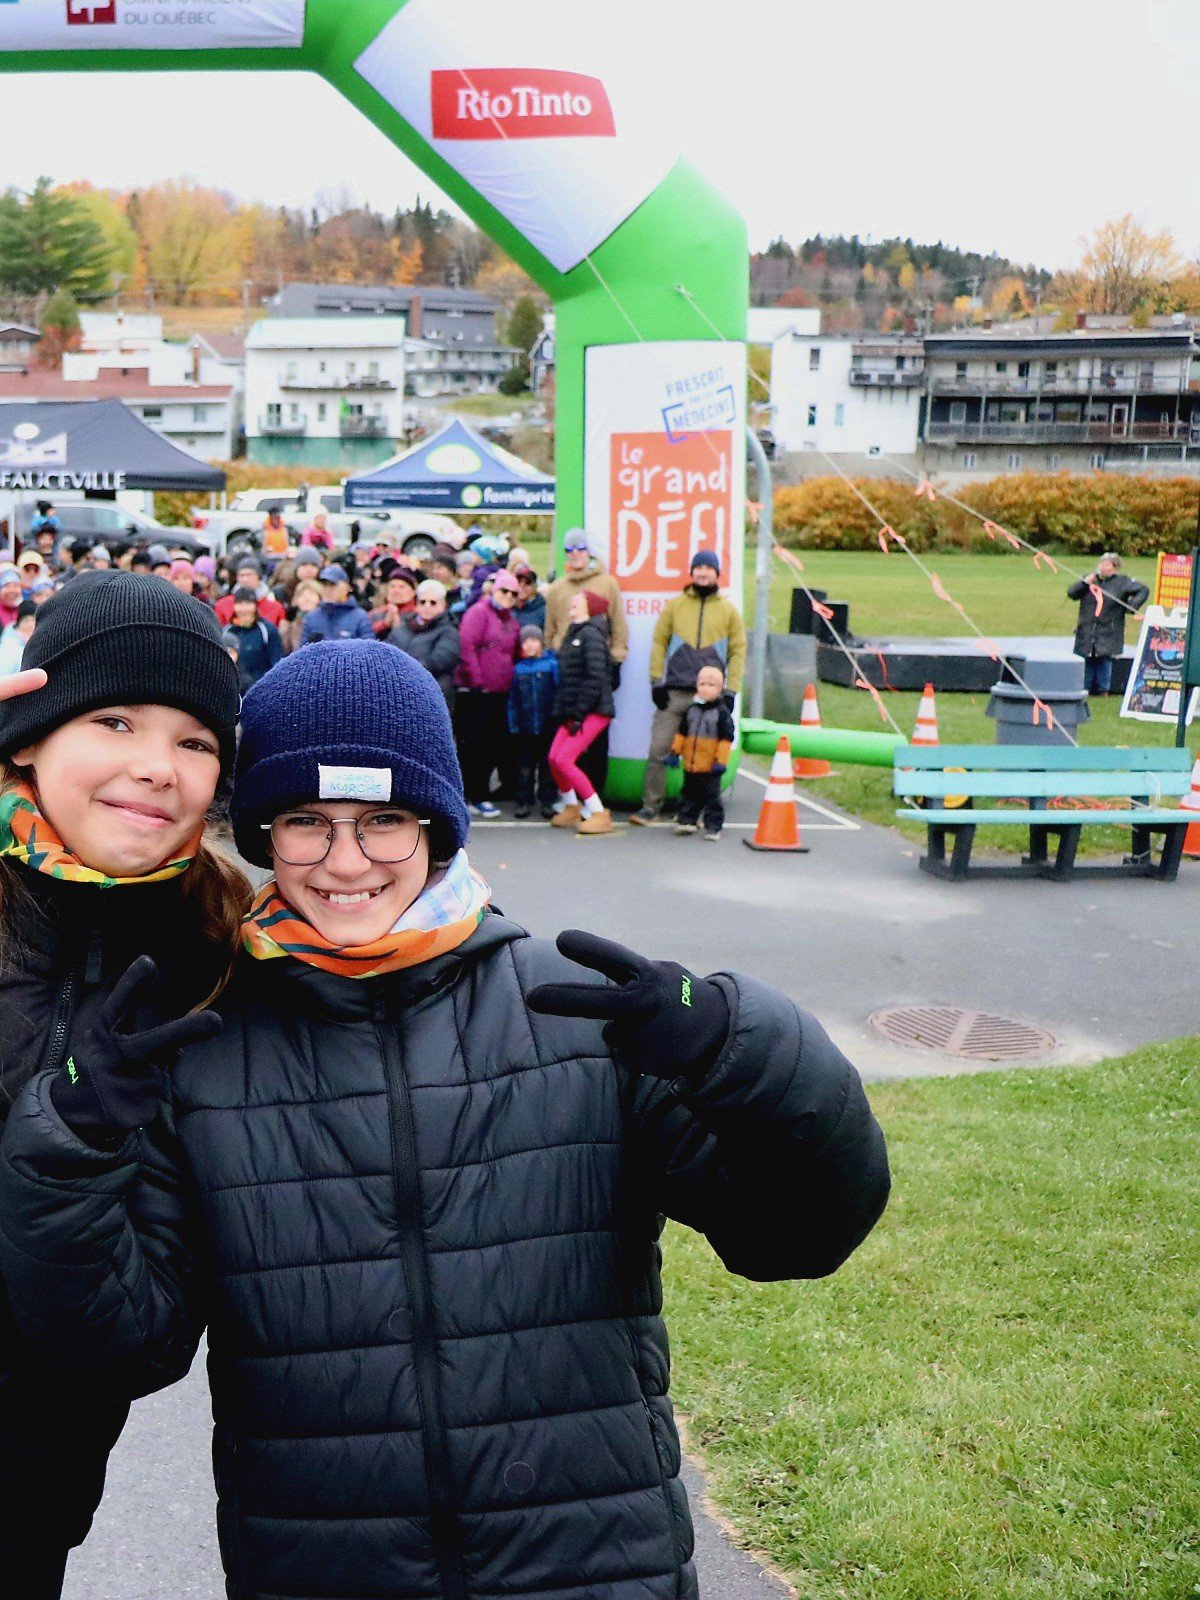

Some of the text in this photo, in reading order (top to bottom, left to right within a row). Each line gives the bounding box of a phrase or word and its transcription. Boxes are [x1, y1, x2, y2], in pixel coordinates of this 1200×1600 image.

[124, 10, 216, 25] DU QUÉBEC
[666, 368, 725, 397] PRESCRIT
[621, 442, 643, 465] le
[618, 453, 727, 508] grand
[615, 500, 725, 578] DÉFI
[331, 783, 381, 794] MARCHE
